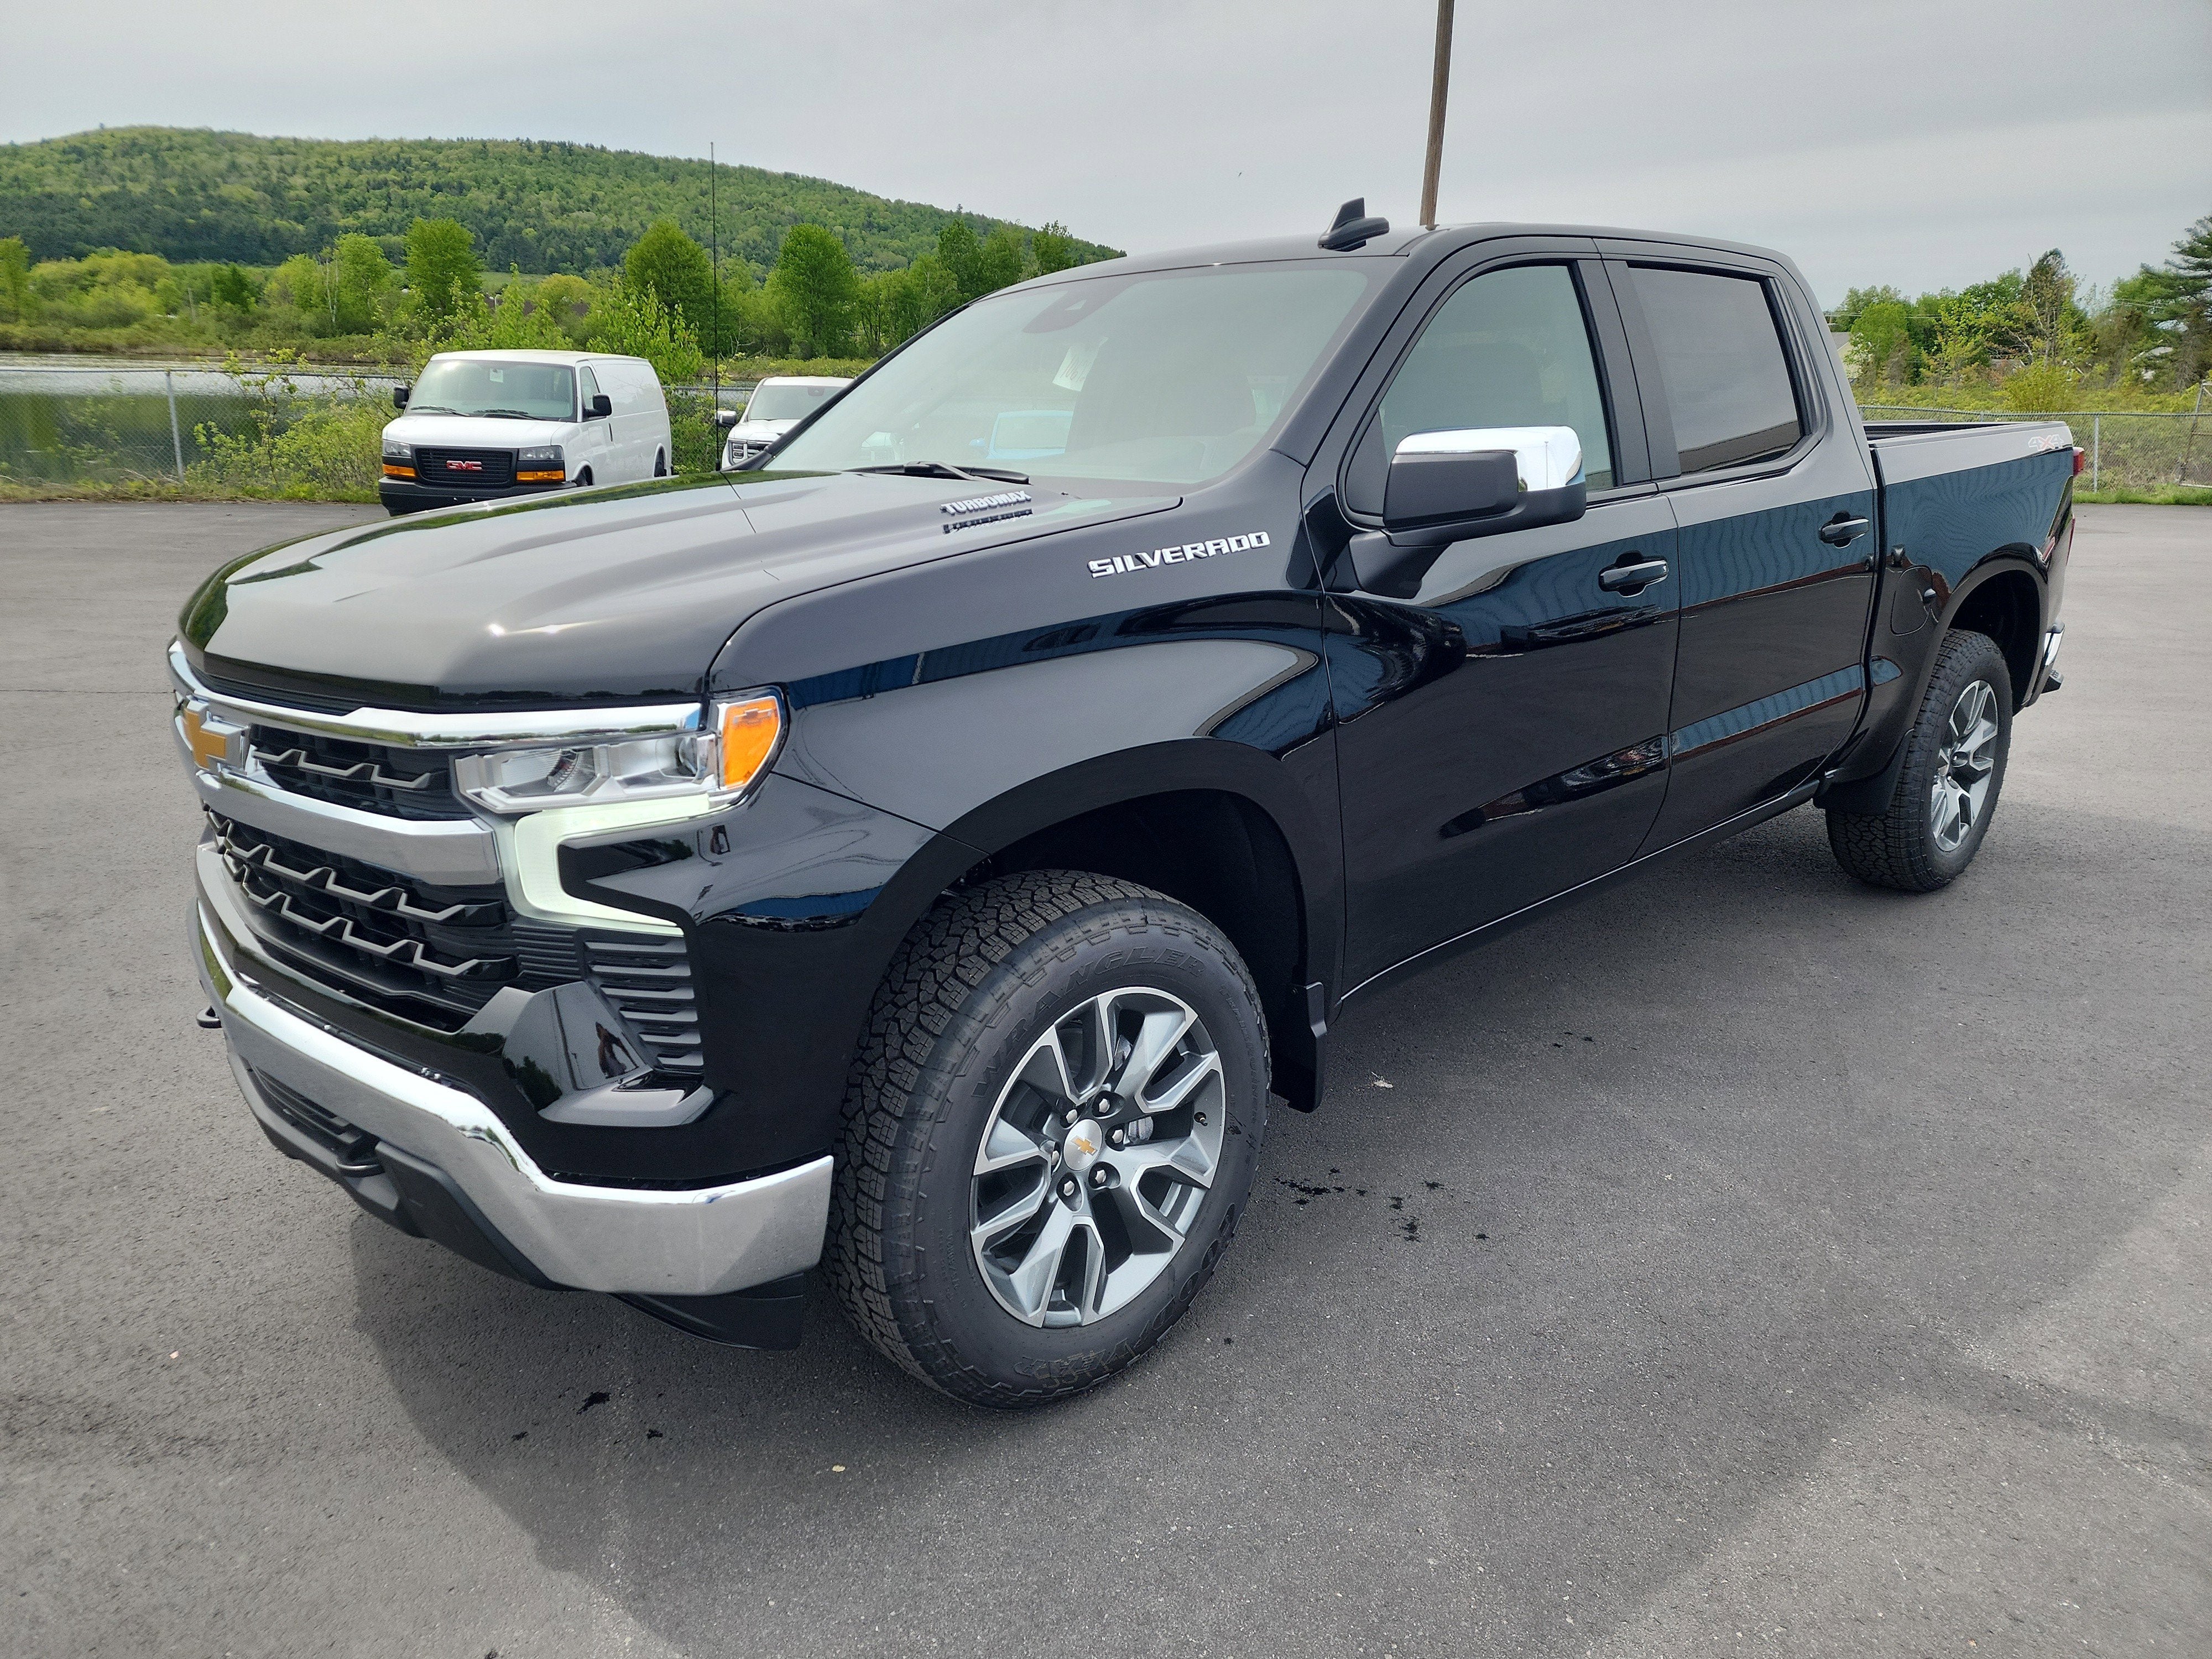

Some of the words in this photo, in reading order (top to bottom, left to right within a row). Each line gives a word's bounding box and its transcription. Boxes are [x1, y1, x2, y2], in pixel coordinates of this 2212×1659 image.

[446, 460, 482, 470] GMC
[940, 490, 1032, 516] TURBOMAX
[1087, 531, 1271, 578] SILVERADO
[971, 946, 1206, 1097] WRANGLER
